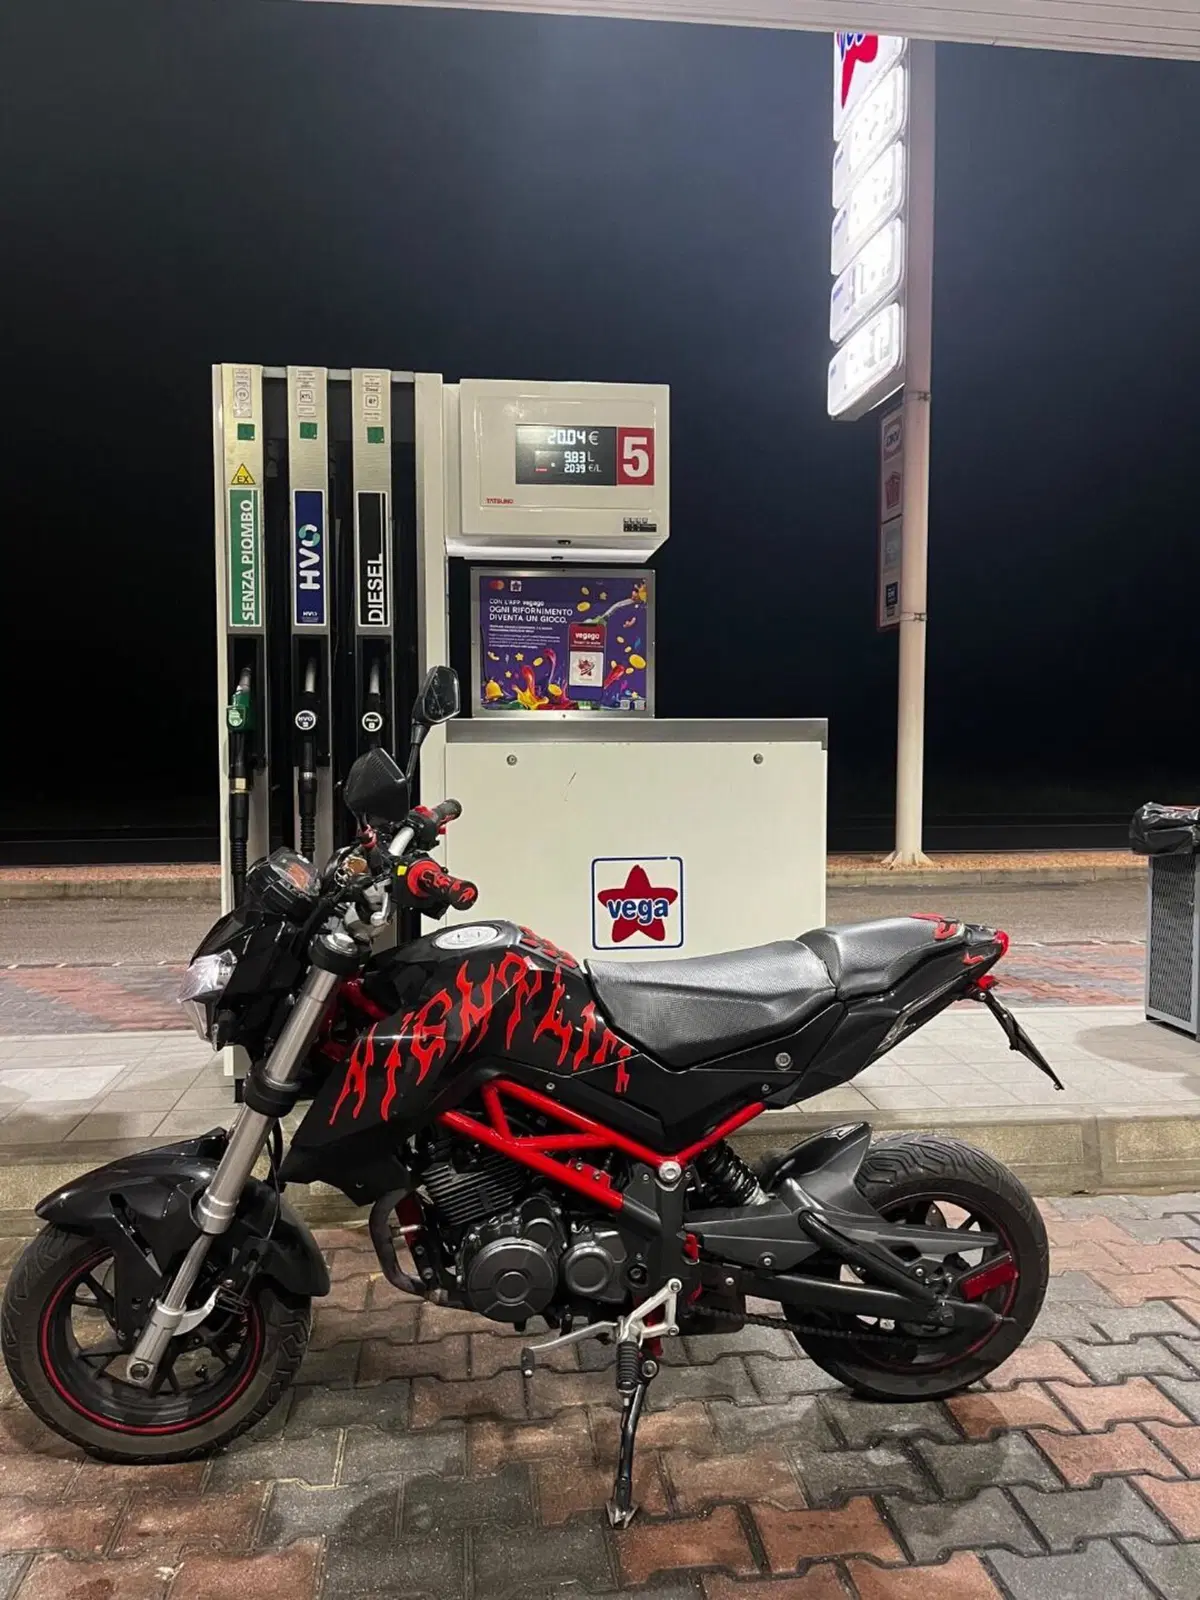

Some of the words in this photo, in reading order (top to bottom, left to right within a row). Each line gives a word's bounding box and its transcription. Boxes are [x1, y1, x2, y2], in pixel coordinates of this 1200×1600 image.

[588, 430, 599, 446] €
[587, 451, 595, 462] L
[622, 436, 650, 477] 5
[237, 475, 249, 484] EX
[240, 499, 253, 564] PIOMBO
[298, 524, 321, 590] HVO
[242, 571, 254, 621] SENZA
[367, 553, 383, 622] DIESEL
[489, 613, 524, 621] DIVENTA
[512, 607, 573, 616] RIFORNIMENTO
[606, 898, 669, 925] vega
